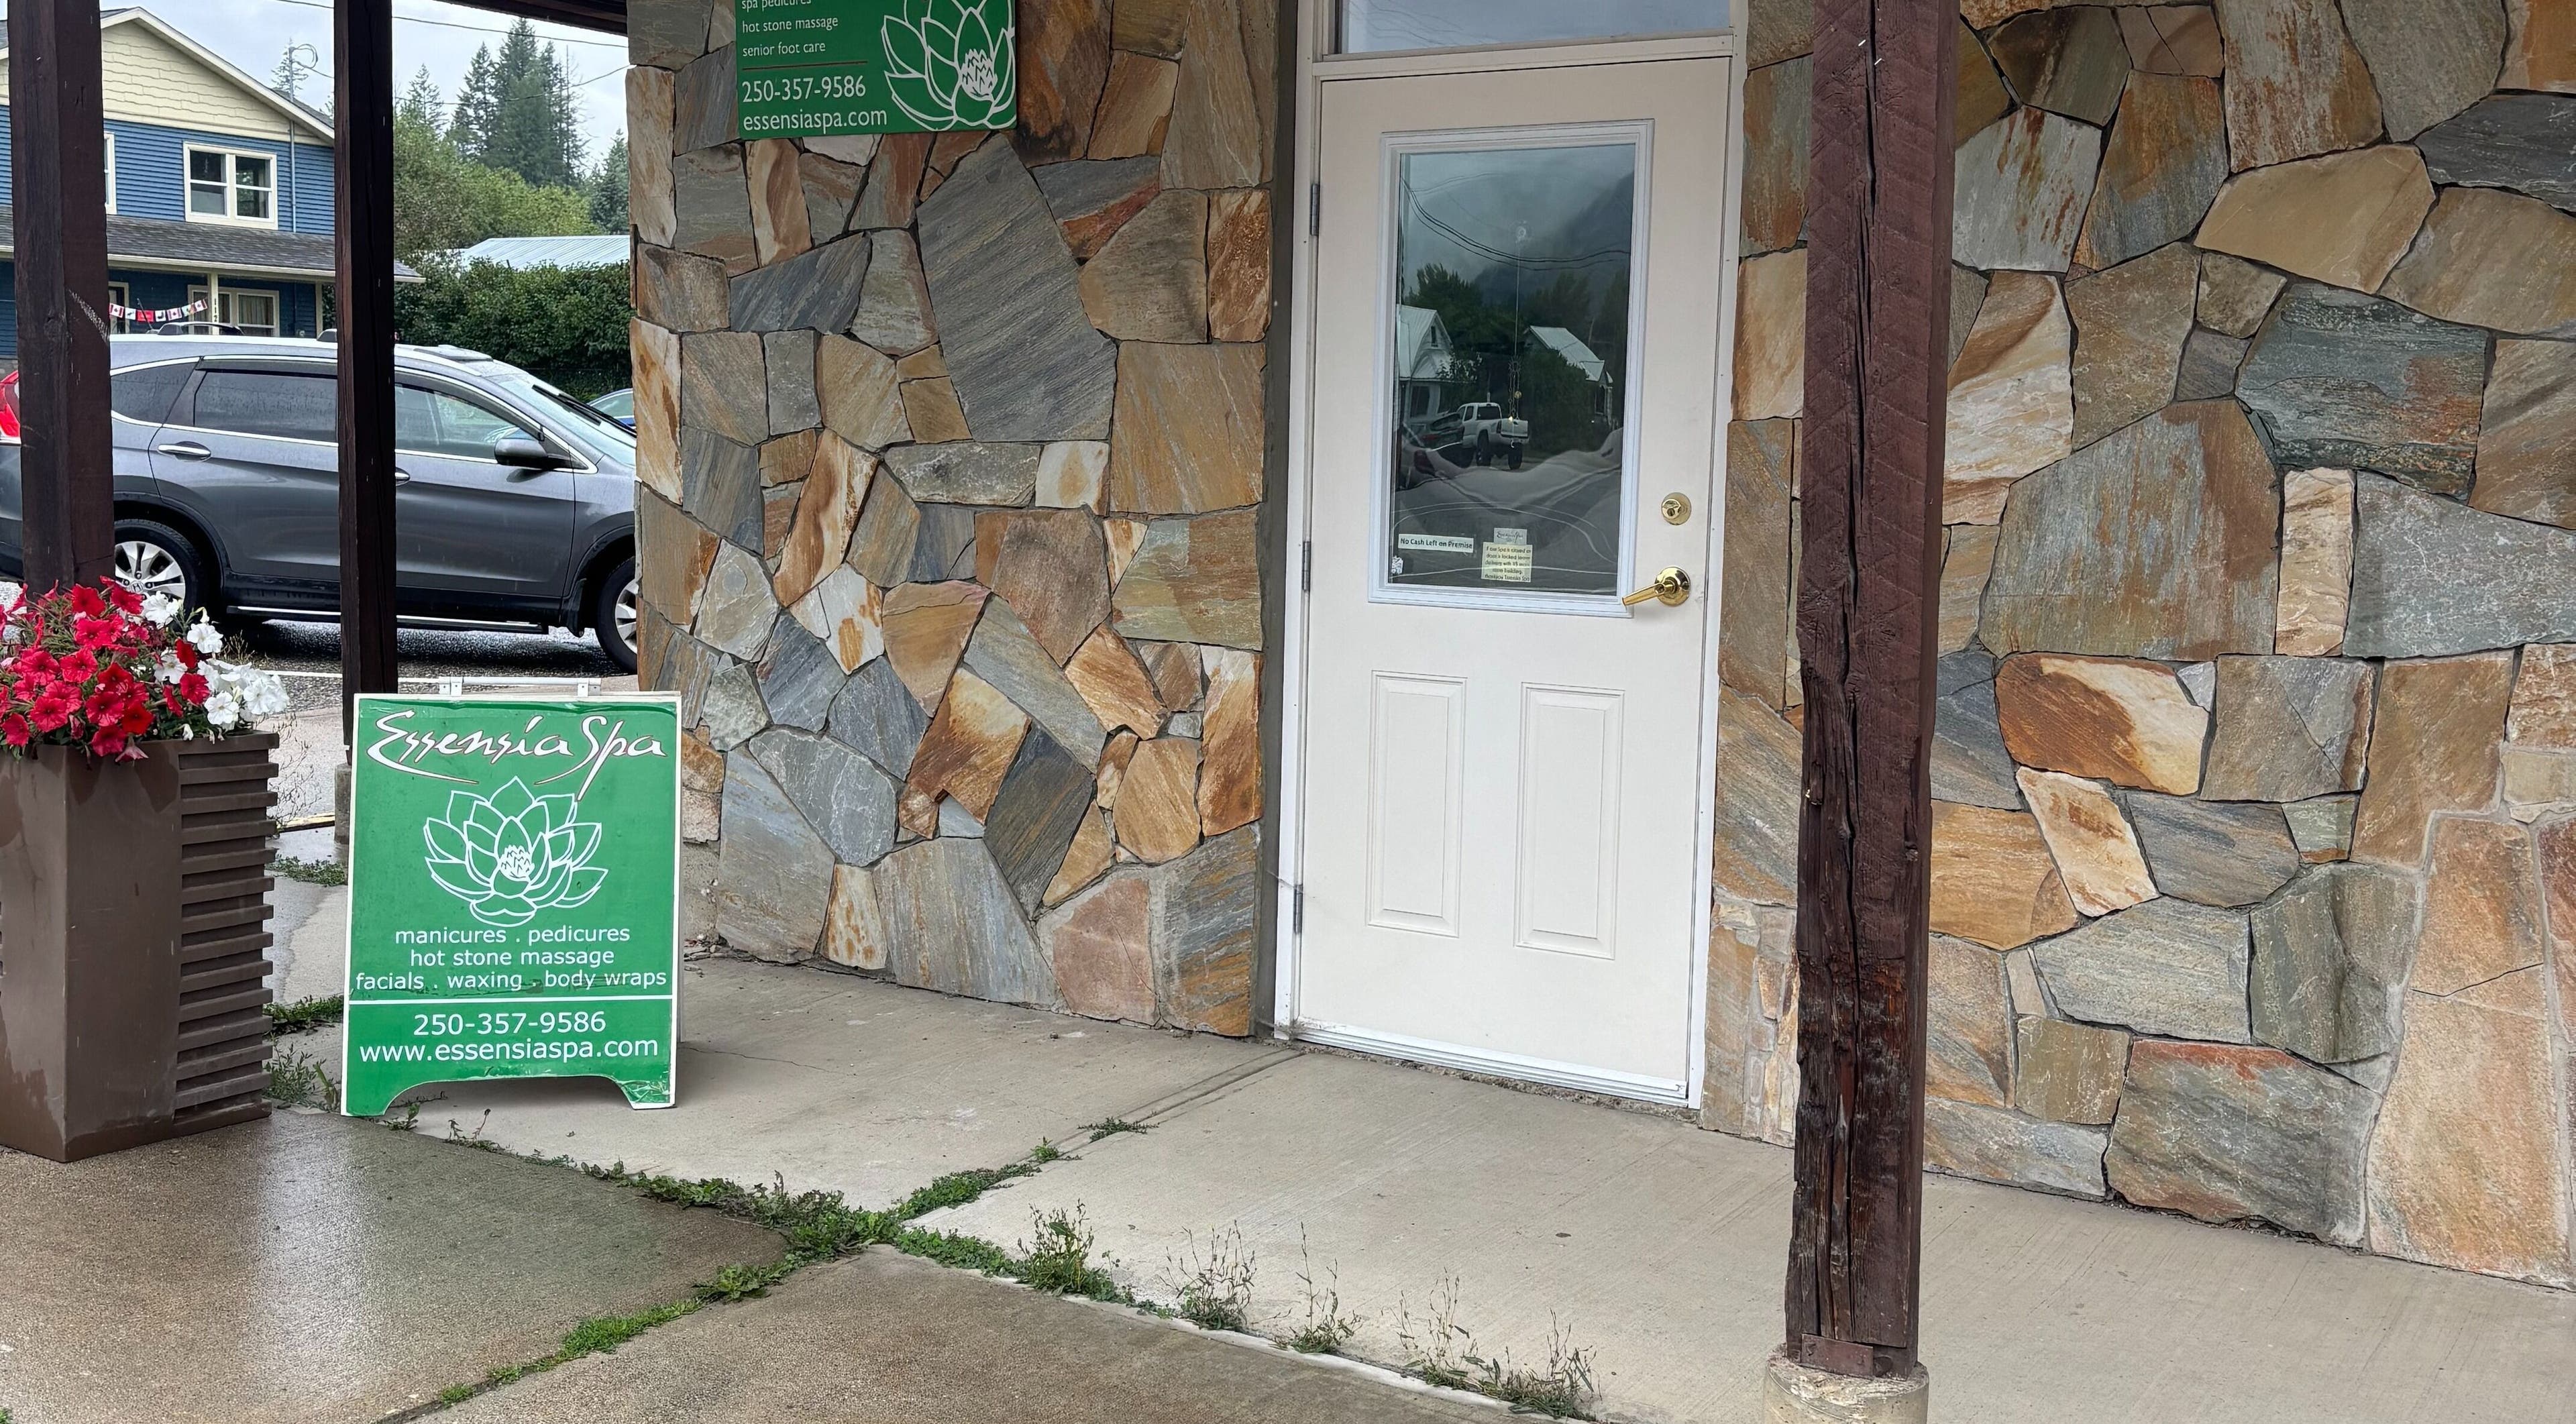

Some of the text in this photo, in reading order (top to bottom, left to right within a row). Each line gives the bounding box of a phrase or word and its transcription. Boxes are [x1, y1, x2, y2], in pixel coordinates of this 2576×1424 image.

[741, 0, 758, 13] spa
[742, 17, 839, 33] hot stone massage
[743, 41, 826, 57] senior foot care
[742, 75, 866, 103] 250-357-9586
[743, 109, 888, 134] essensiaspa.com
[533, 716, 667, 802] Spa
[395, 924, 631, 944] manicures pedicures
[411, 949, 615, 968] hot stone massage
[356, 970, 667, 991] facials waxing body wraps
[413, 1010, 607, 1036] 250-357-9586
[360, 1038, 659, 1062] www.essensiaspa.com
